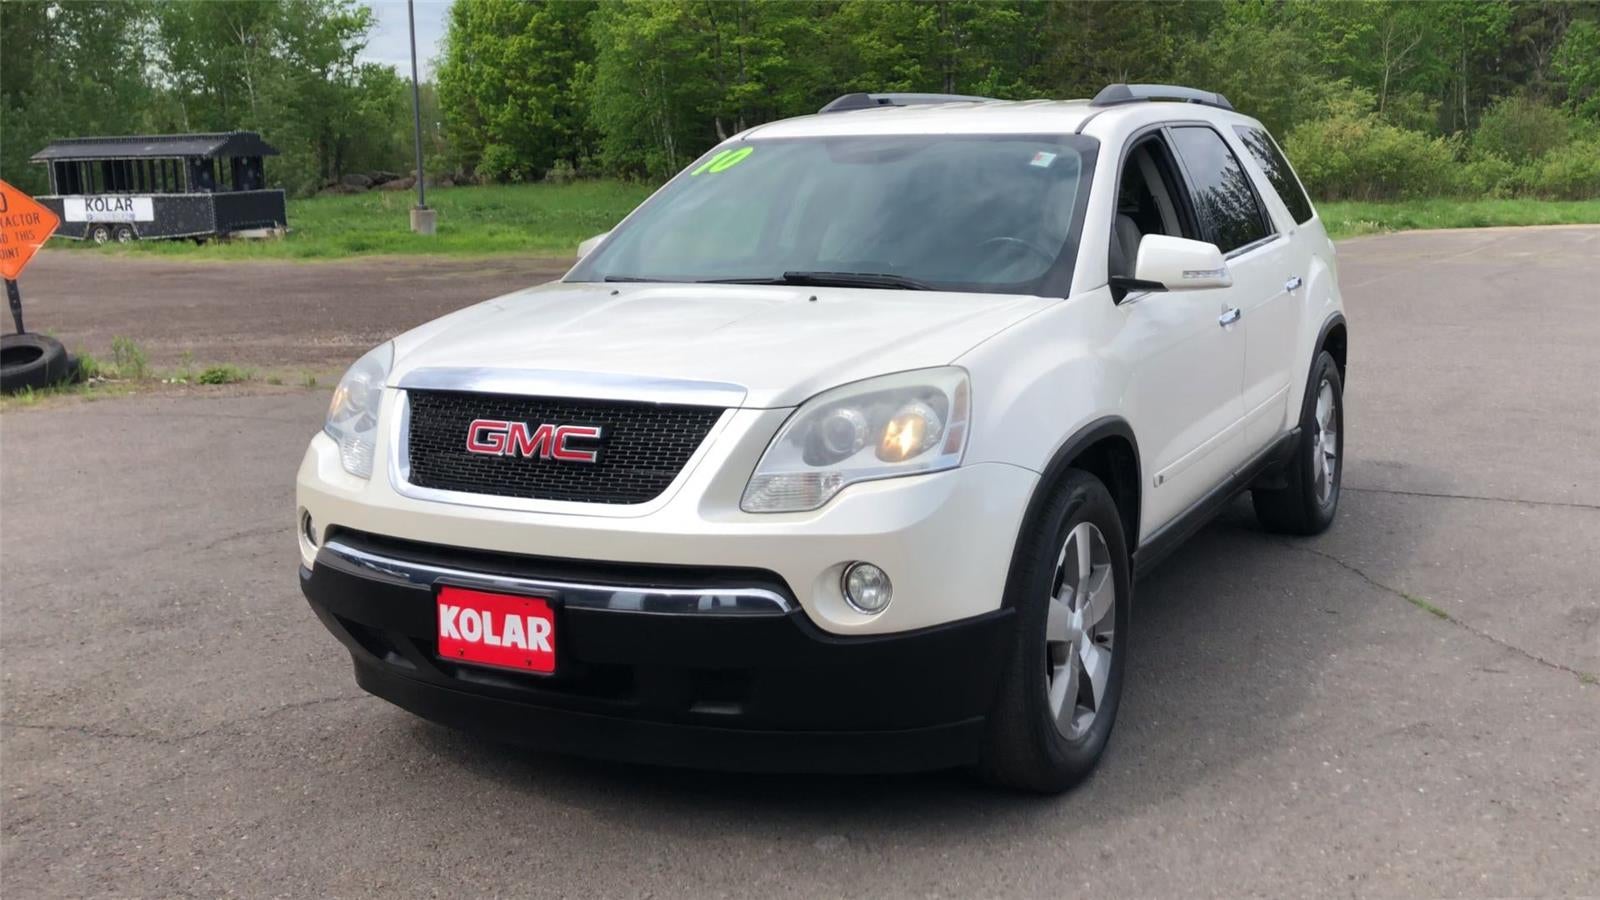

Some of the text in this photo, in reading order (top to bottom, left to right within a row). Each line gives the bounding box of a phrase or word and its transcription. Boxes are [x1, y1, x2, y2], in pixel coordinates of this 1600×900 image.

[84, 196, 134, 212] KOLAR
[15, 230, 36, 242] THIS
[466, 418, 602, 462] GMC
[439, 603, 553, 653] KOLAR
